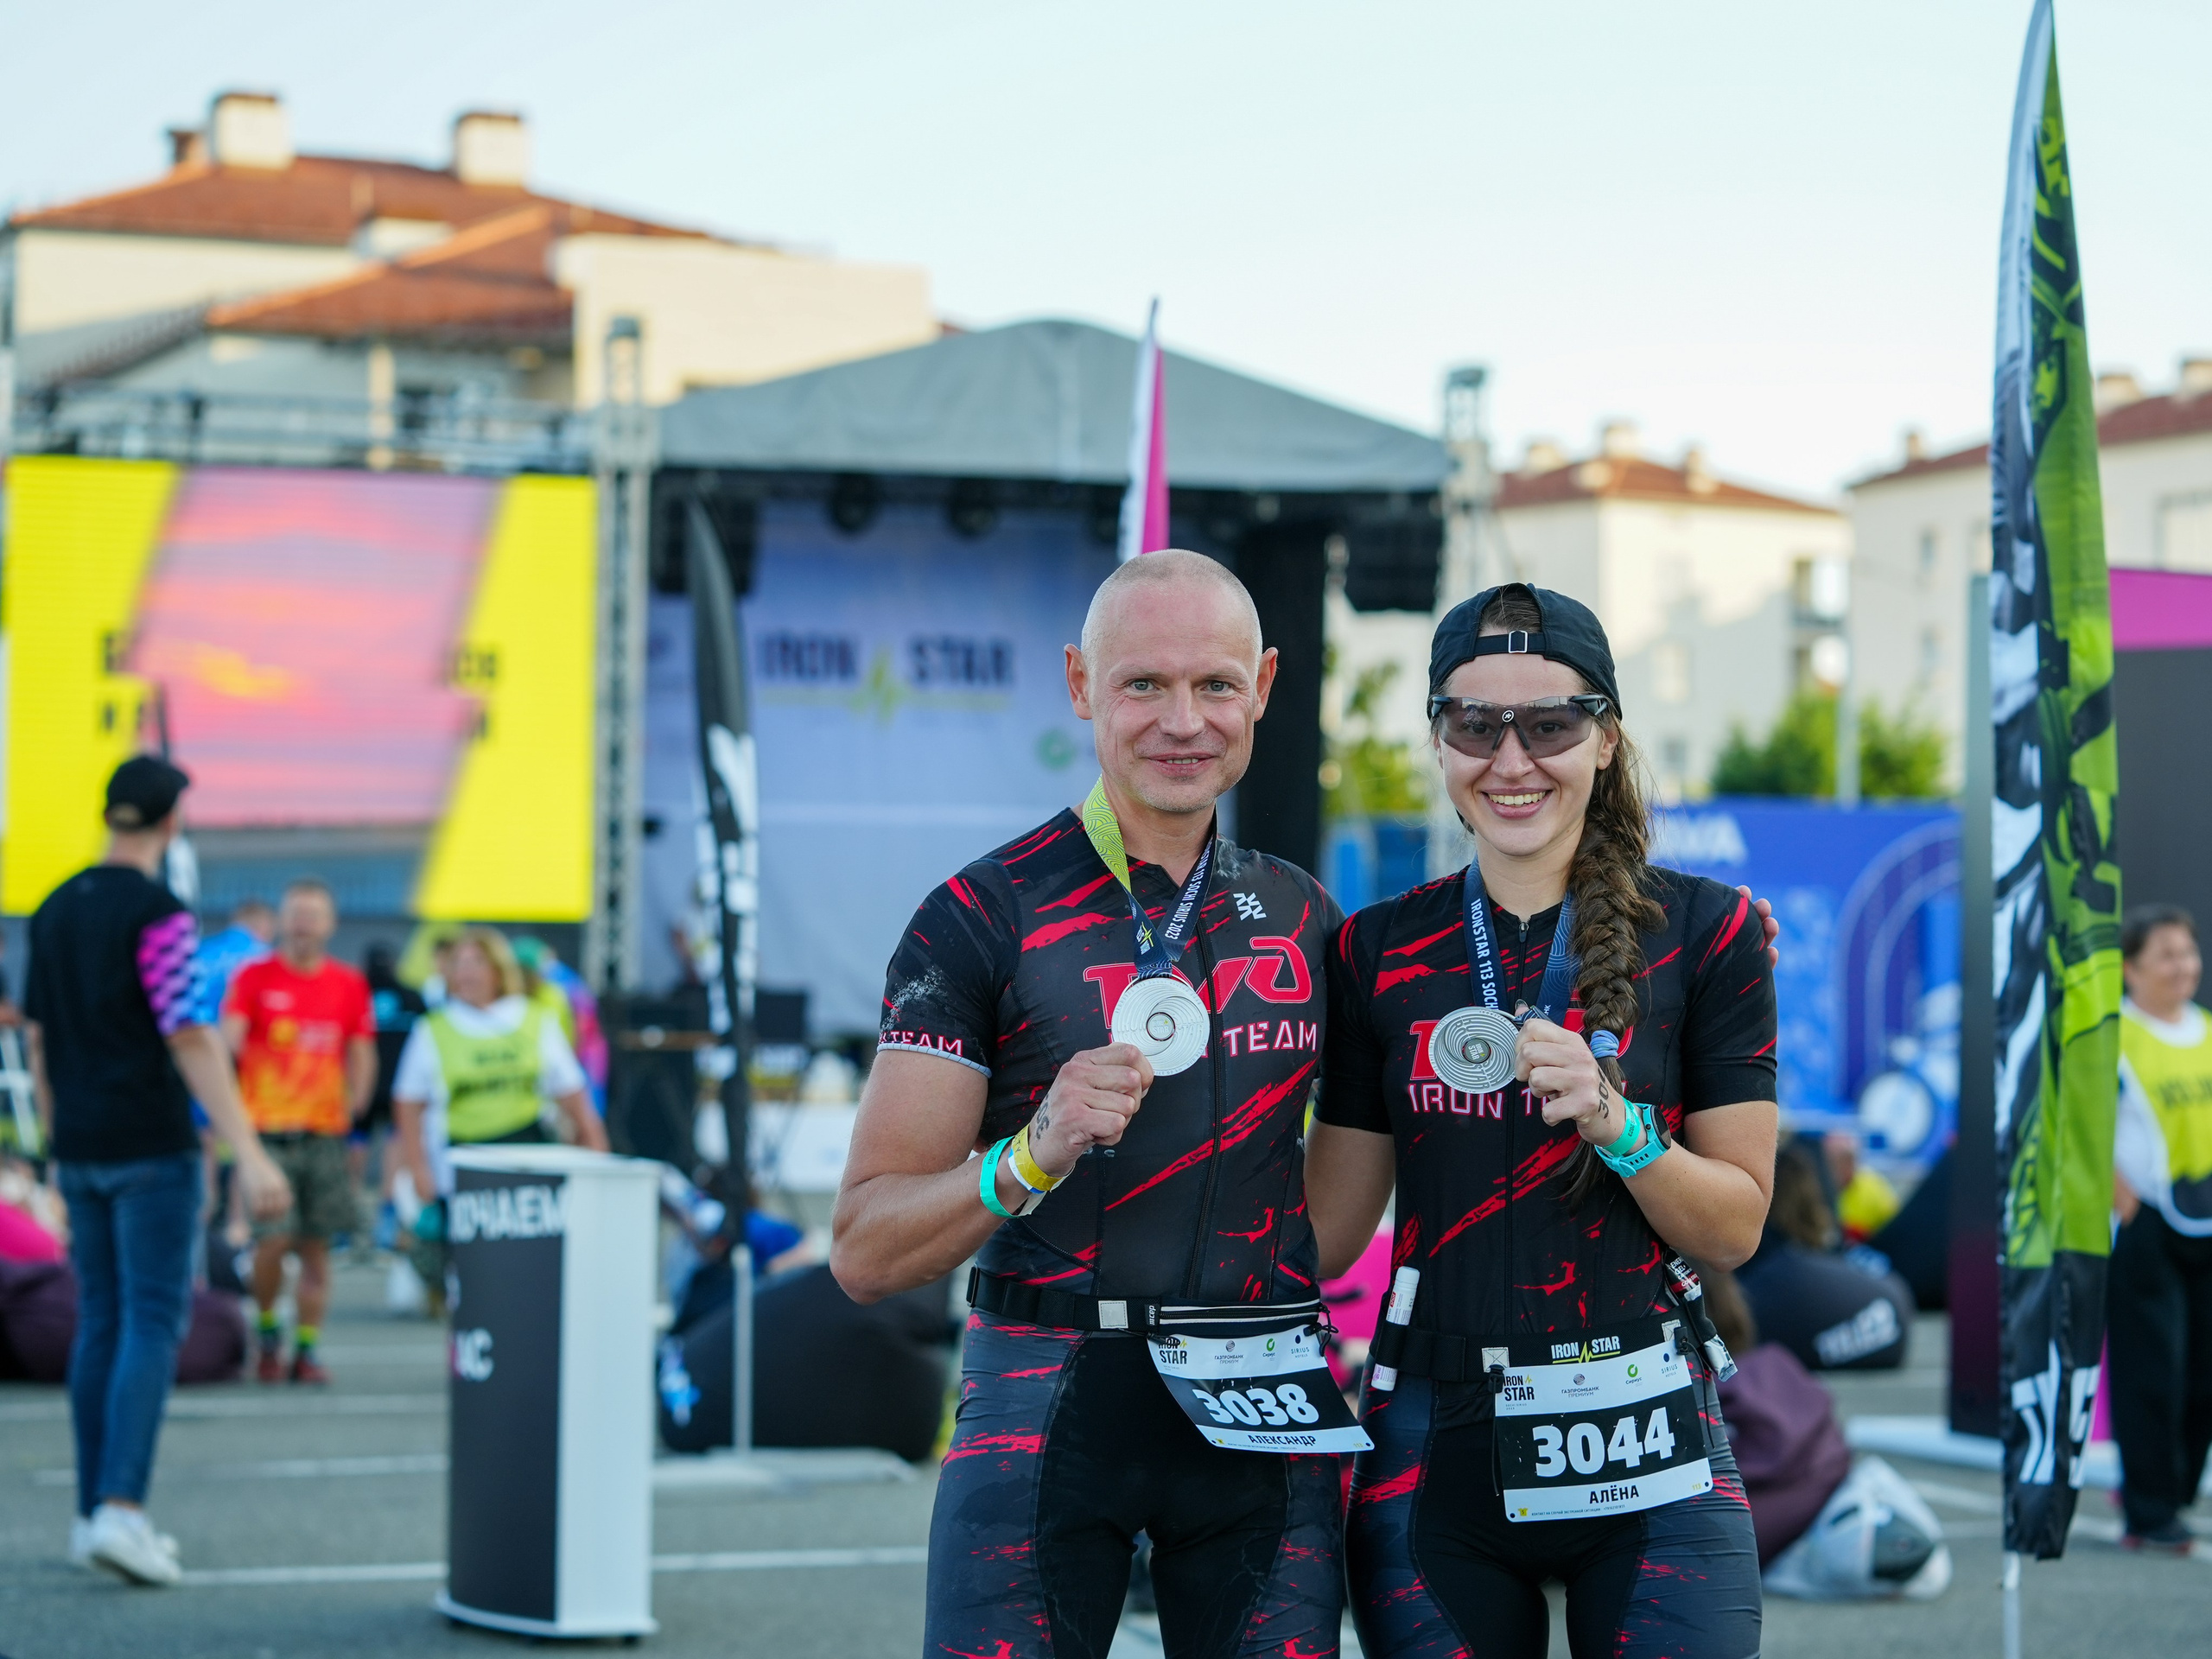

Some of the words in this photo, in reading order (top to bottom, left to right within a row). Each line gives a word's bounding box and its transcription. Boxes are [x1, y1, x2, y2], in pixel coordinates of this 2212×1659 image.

[763, 632, 857, 679] IRON
[908, 636, 1012, 683] STAR
[1182, 878, 1202, 901] SOCHI
[1173, 899, 1193, 923] SIRIUS
[1165, 919, 1184, 940] 2023
[1471, 898, 1491, 959] IRONSTAR
[1478, 960, 1494, 981] 113
[890, 1030, 963, 1058] TEAM
[1222, 1019, 1318, 1058] TEAM
[1469, 1045, 1480, 1060] STAR
[1408, 1082, 1503, 1120] IRON
[1159, 1350, 1187, 1364] STAR
[1291, 1346, 1310, 1355] SIRIUS
[1551, 1343, 1580, 1359] IRON
[1592, 1336, 1621, 1353] STAR
[1661, 1363, 1679, 1375] SIRIUS
[1503, 1375, 1523, 1387] IRON
[1560, 1385, 1600, 1395] ГАЗПРОМБАНК
[1625, 1376, 1643, 1386] Сириус
[1192, 1383, 1319, 1426] 3038
[1503, 1386, 1535, 1402] STAR
[1247, 1434, 1317, 1446] АЛЕКСАНДР
[1532, 1406, 1676, 1478] 3044
[1589, 1484, 1640, 1504] АЛЁНА
